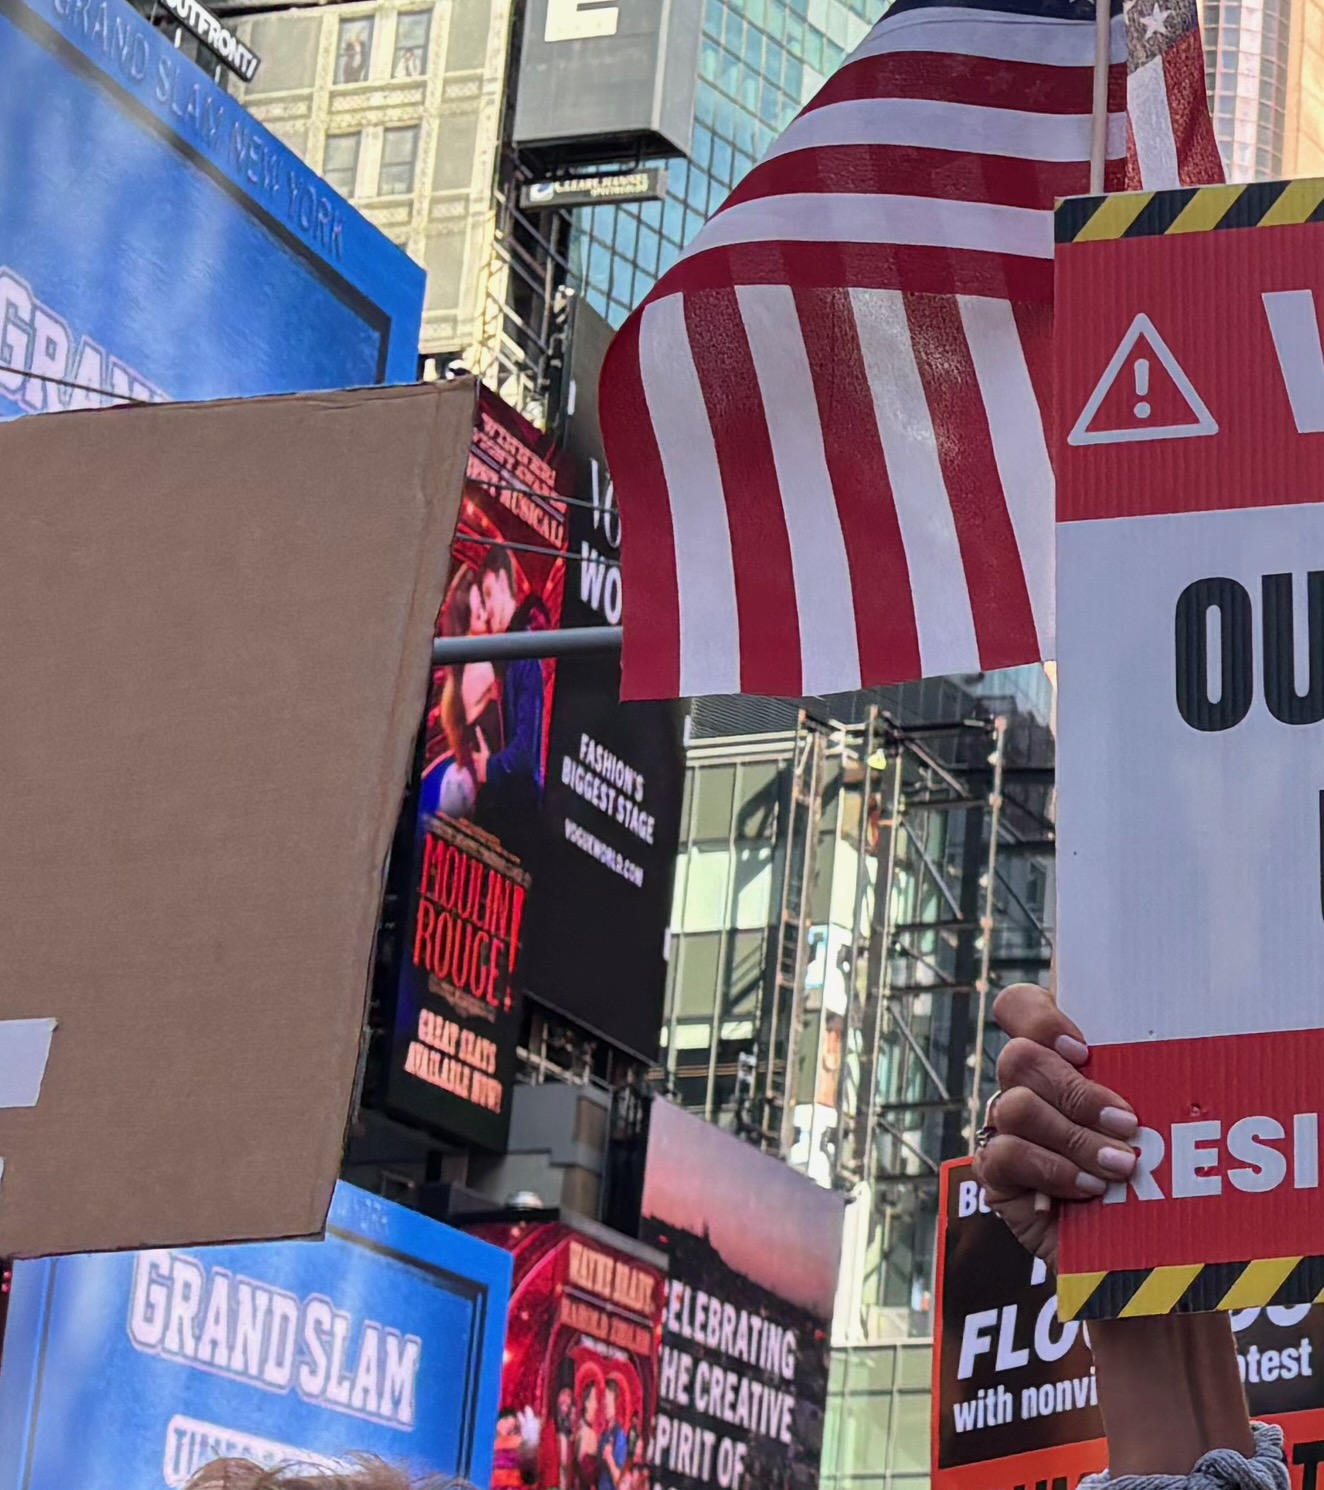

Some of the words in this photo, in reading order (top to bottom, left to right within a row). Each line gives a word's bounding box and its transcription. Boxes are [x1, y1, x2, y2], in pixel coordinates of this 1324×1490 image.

[561, 755, 617, 817] BIGGEST
[615, 795, 656, 845] STAGE
[420, 831, 513, 939] MOULIN
[126, 1247, 299, 1394] GRAND
[300, 1290, 422, 1432] SLAM
[664, 1278, 798, 1381] ELEBRATING
[957, 1304, 1093, 1381] FLO
[659, 1346, 690, 1407] HE
[694, 1360, 798, 1444] CREATIVE
[952, 1387, 1013, 1434] with
[1020, 1369, 1098, 1419] nonvi
[648, 1415, 716, 1479] PIRIT
